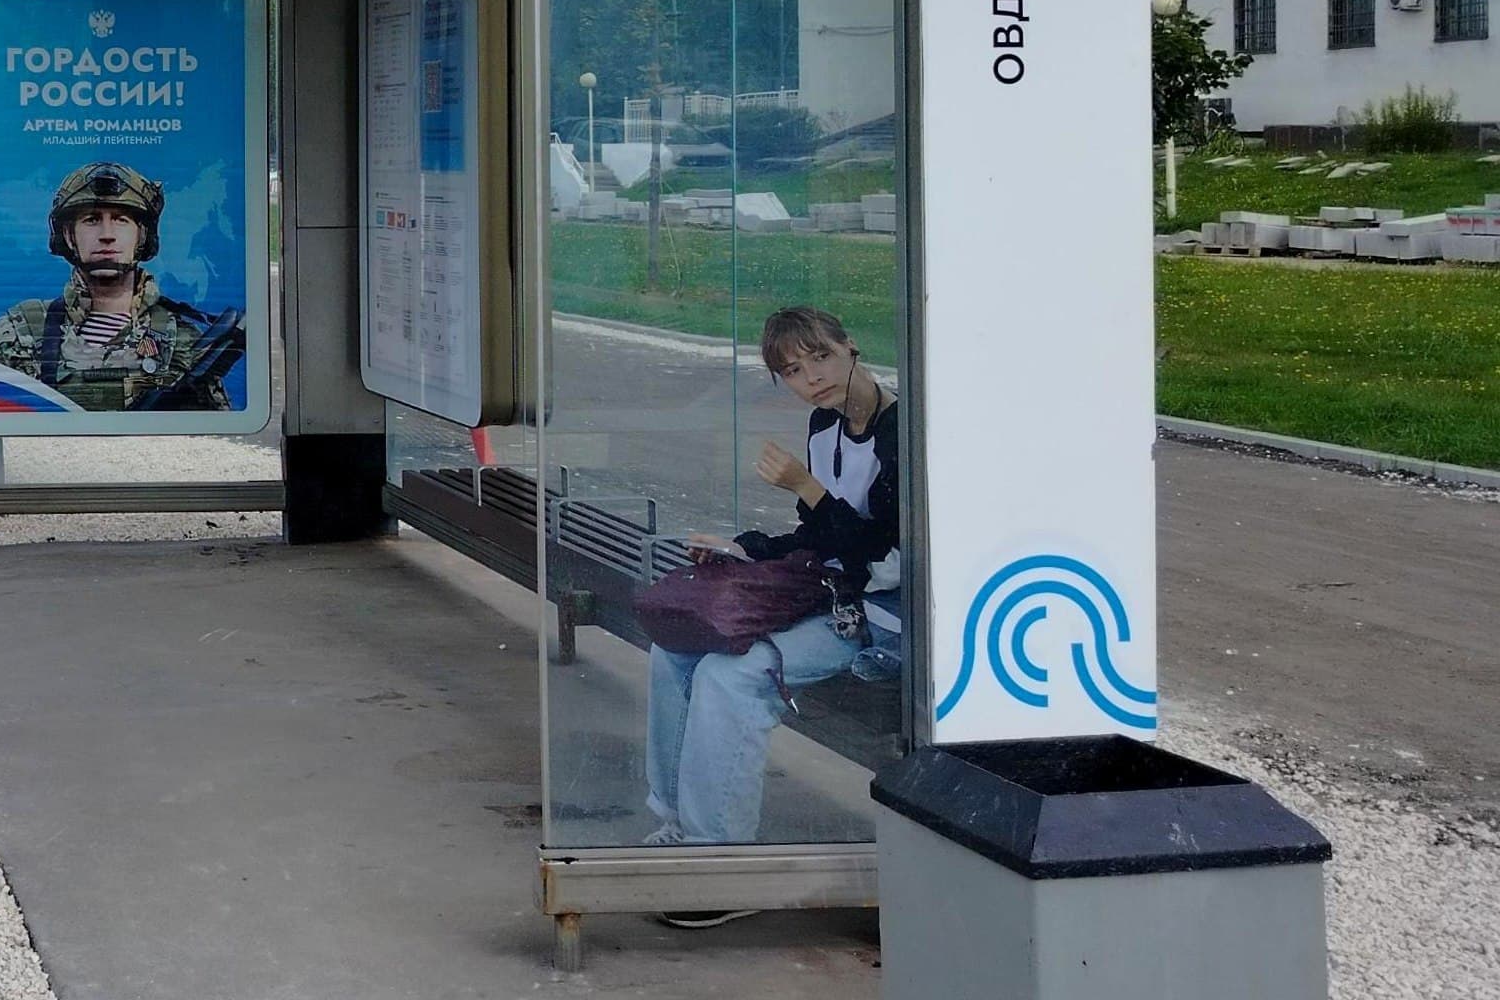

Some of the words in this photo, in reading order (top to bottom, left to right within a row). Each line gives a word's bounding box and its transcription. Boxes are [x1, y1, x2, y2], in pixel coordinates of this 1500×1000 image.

[6, 47, 199, 76] ГОРДОСТЬ
[19, 81, 185, 107] РОССИИ!
[23, 118, 79, 132] АРТЕМ
[84, 118, 182, 133] РОМАНЦОВ
[42, 134, 101, 145] МЛАДШИЙ
[103, 134, 164, 145] ЛЕЙТЕНАНТ
